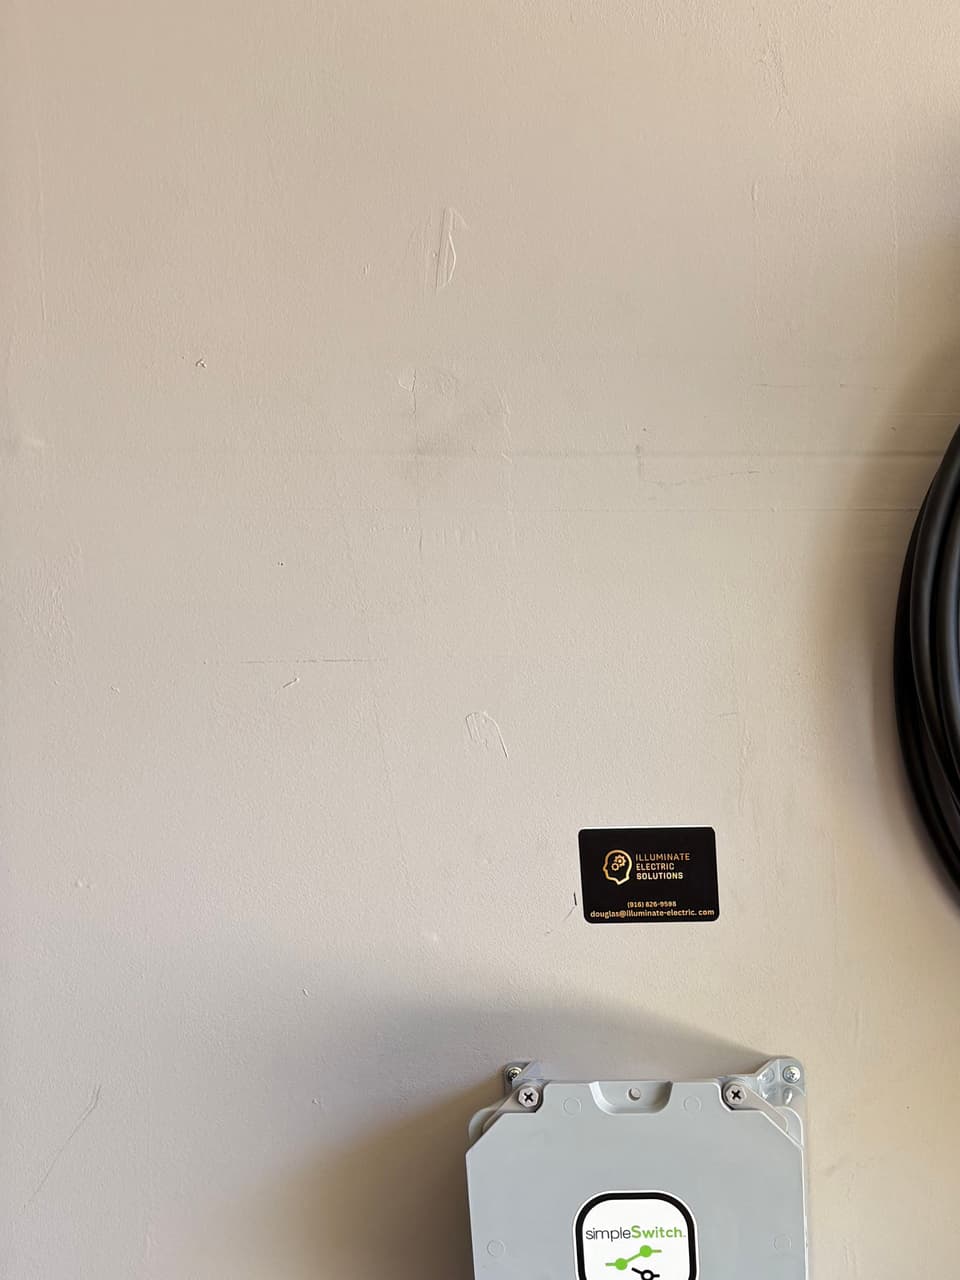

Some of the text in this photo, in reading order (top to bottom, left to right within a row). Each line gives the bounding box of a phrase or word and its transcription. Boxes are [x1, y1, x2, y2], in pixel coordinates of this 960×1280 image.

[635, 852, 691, 861] ILLUMINATE
[635, 862, 675, 871] ELECTRIC
[636, 871, 684, 880] SOLUTIONS
